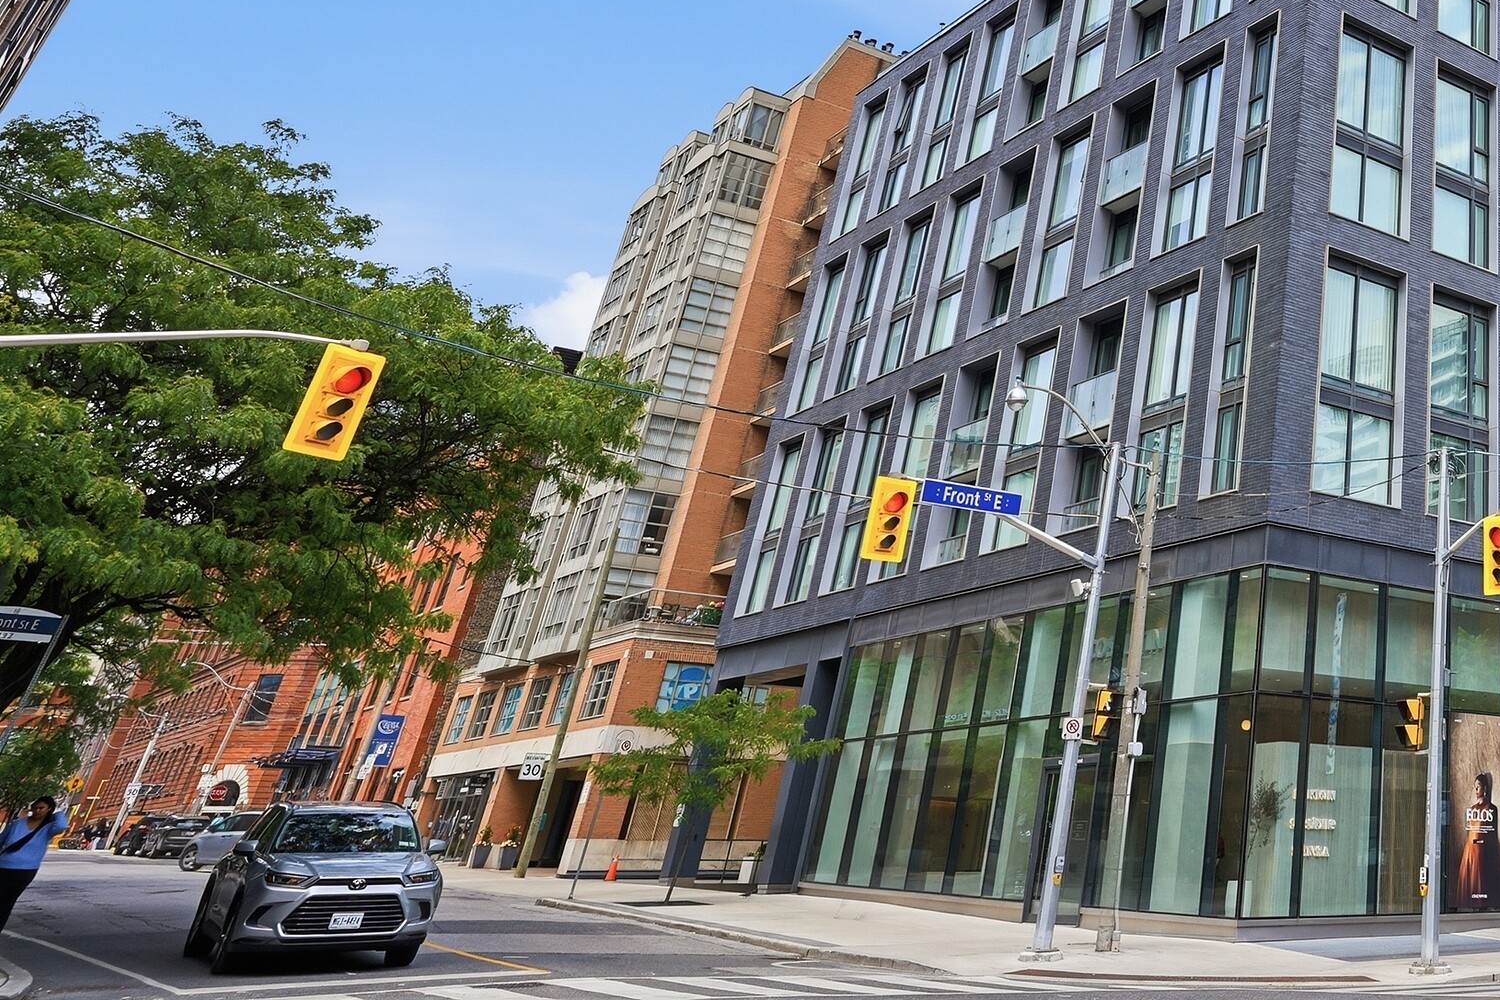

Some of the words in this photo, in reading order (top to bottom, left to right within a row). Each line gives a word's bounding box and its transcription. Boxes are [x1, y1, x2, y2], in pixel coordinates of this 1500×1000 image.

[942, 486, 980, 507] Front
[984, 492, 992, 502] St
[993, 495, 1003, 510] E
[30, 619, 41, 631] E
[522, 763, 542, 777] 30
